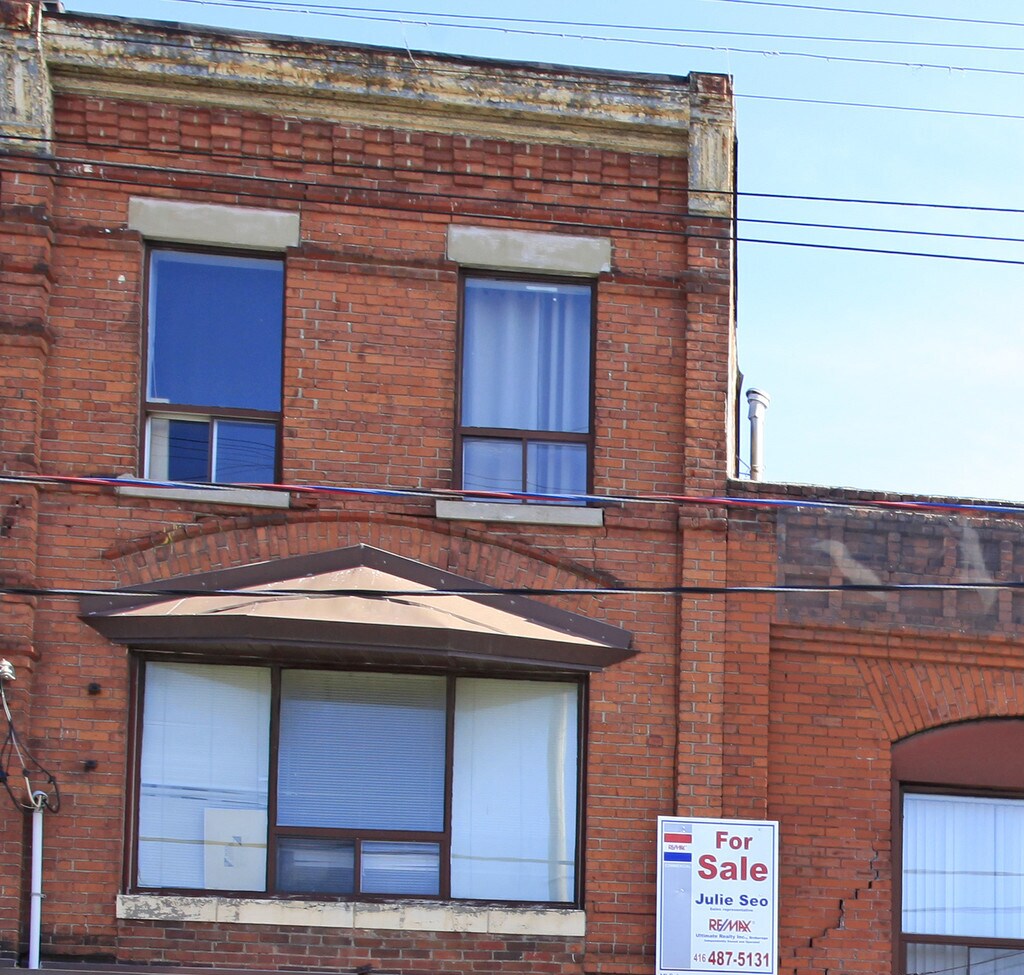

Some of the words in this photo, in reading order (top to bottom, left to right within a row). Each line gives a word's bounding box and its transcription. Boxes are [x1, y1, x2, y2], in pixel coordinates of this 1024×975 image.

[716, 831, 753, 850] For
[697, 854, 769, 881] Sale
[695, 893, 734, 906] Julie
[739, 894, 769, 907] Seo
[709, 918, 752, 932] RE/MAX
[693, 953, 707, 963] 416
[708, 951, 769, 968] 487-5131
